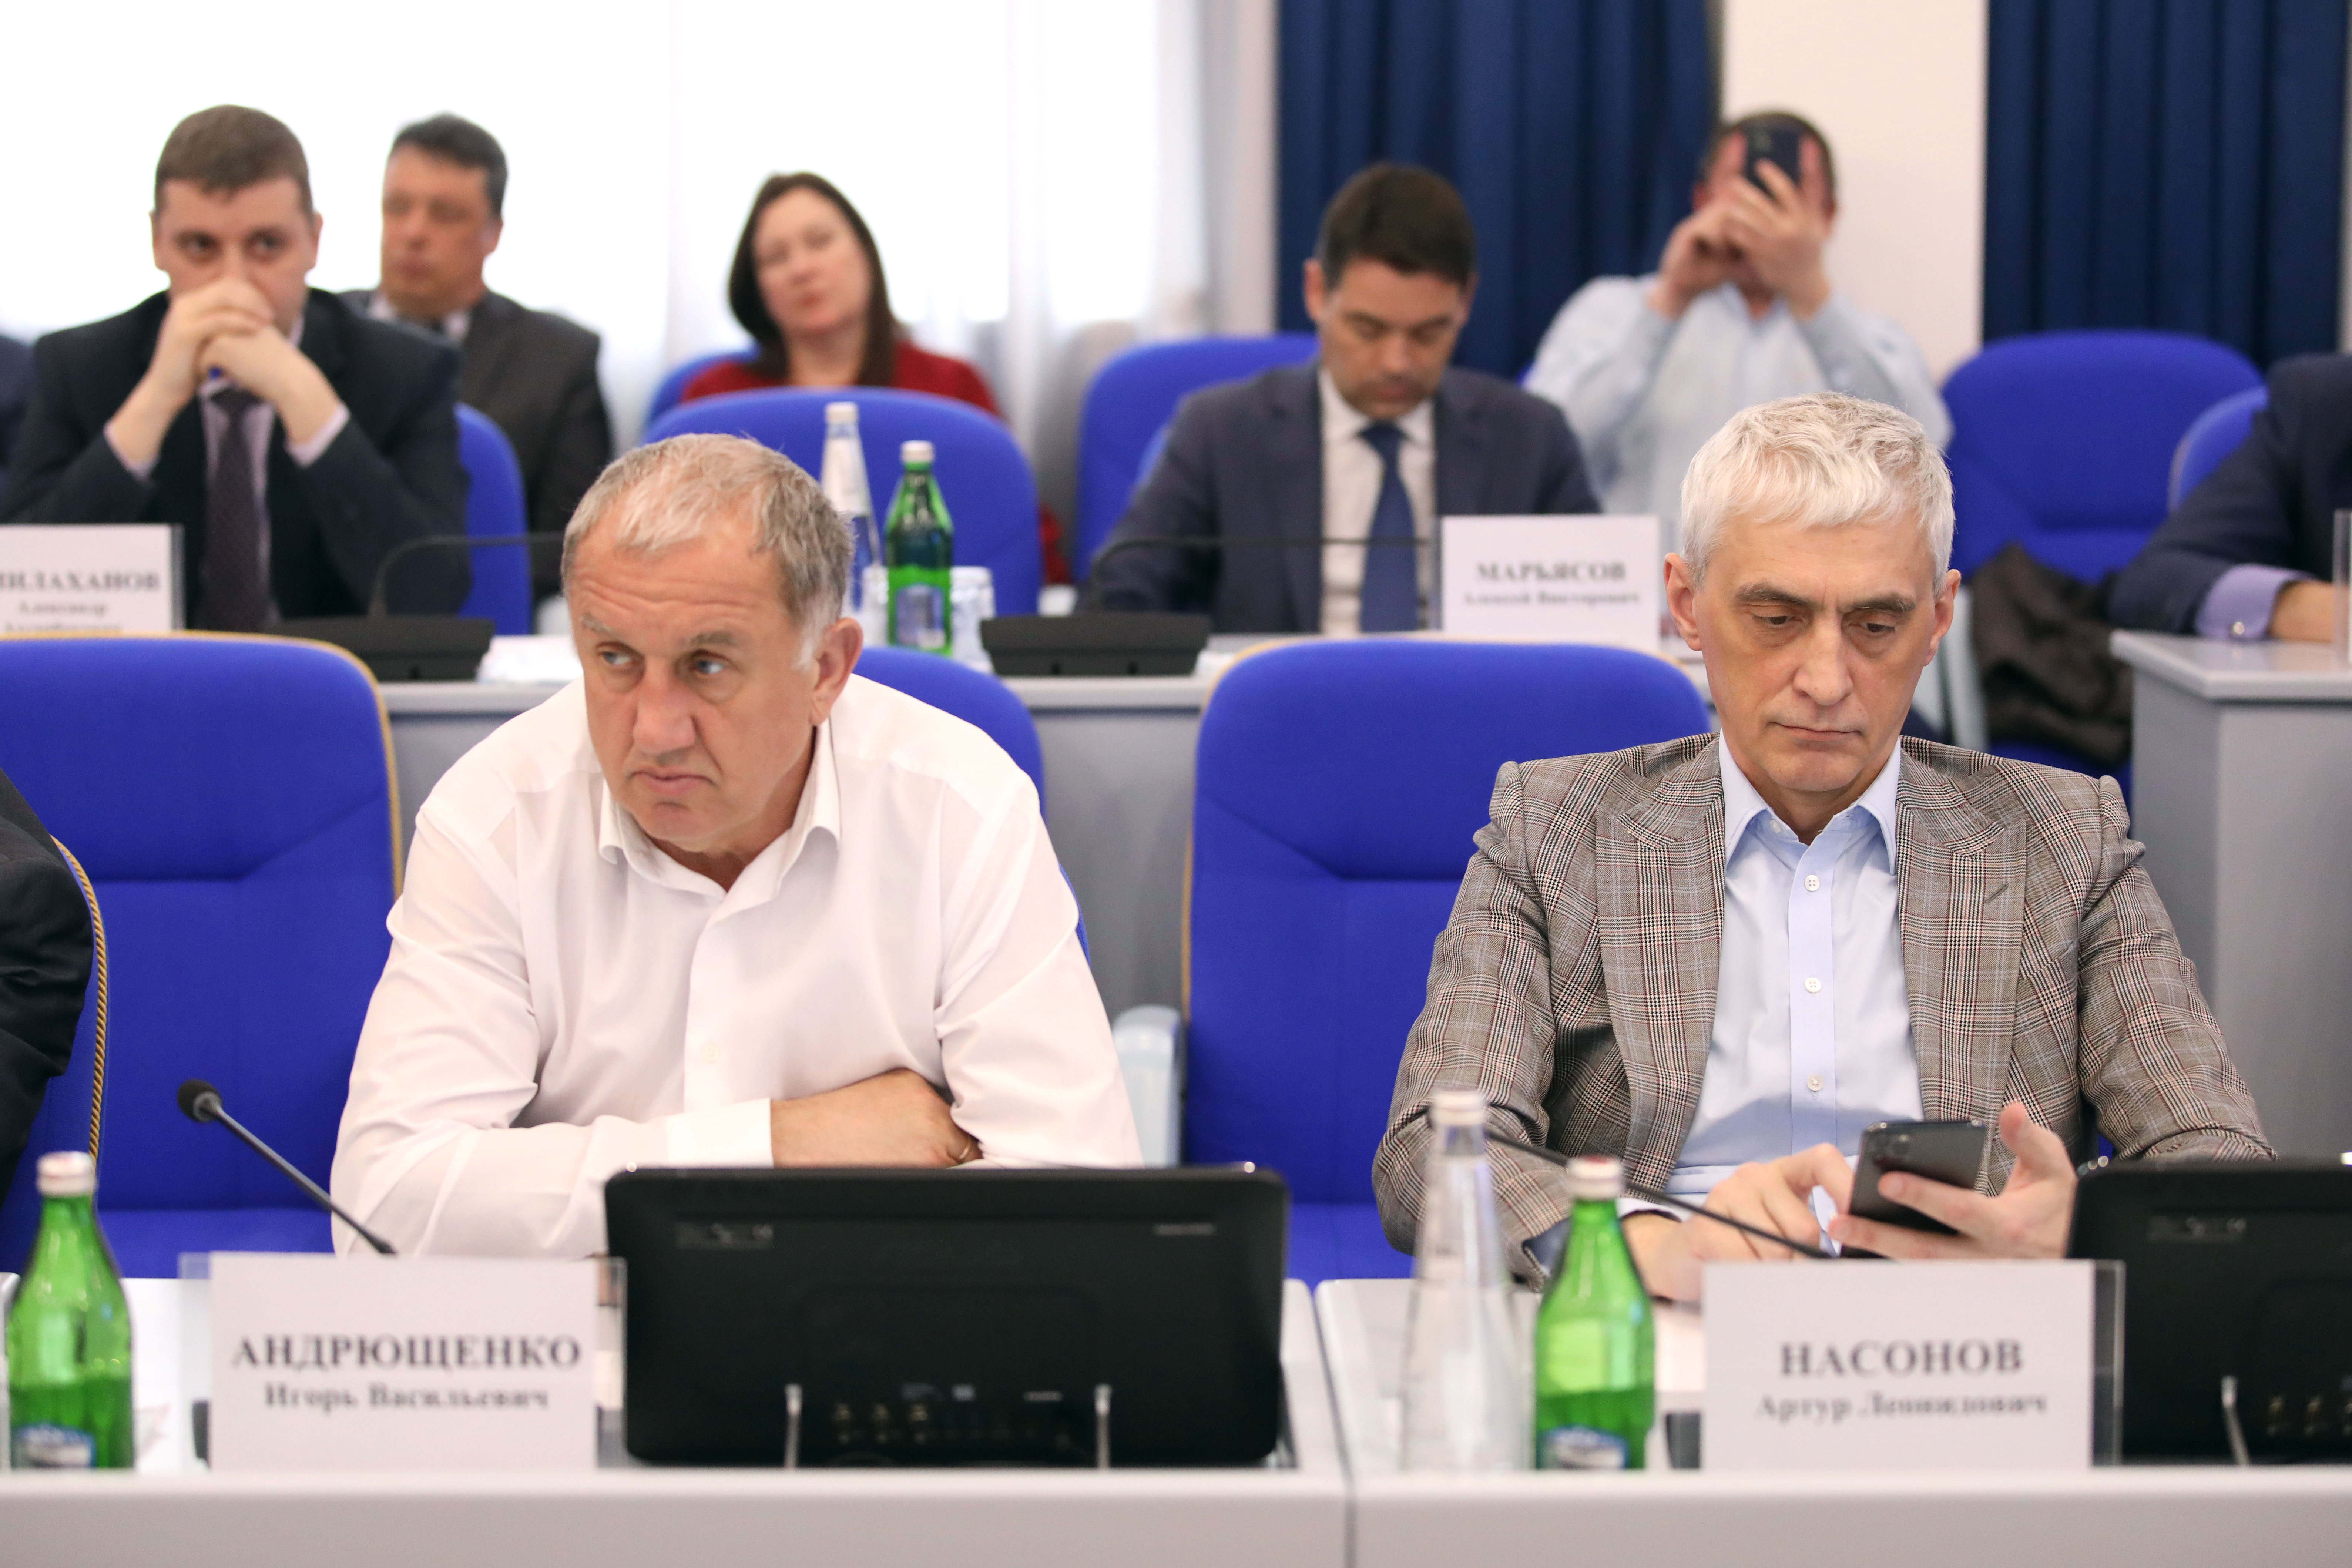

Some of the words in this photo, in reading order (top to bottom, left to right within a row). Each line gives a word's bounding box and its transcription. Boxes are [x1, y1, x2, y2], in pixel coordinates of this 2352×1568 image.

[0, 570, 160, 591] ИЛАХАНОВ
[1476, 560, 1626, 581] МАРЬЯСОВ
[232, 1334, 582, 1371] АНДРЮЩЕНКО
[1779, 1339, 2024, 1377] НАСОНОВ
[264, 1382, 359, 1414] Игорь
[368, 1383, 548, 1409] Васильевич
[1754, 1393, 1852, 1426] Артур
[1856, 1390, 2047, 1418] Леонидович
